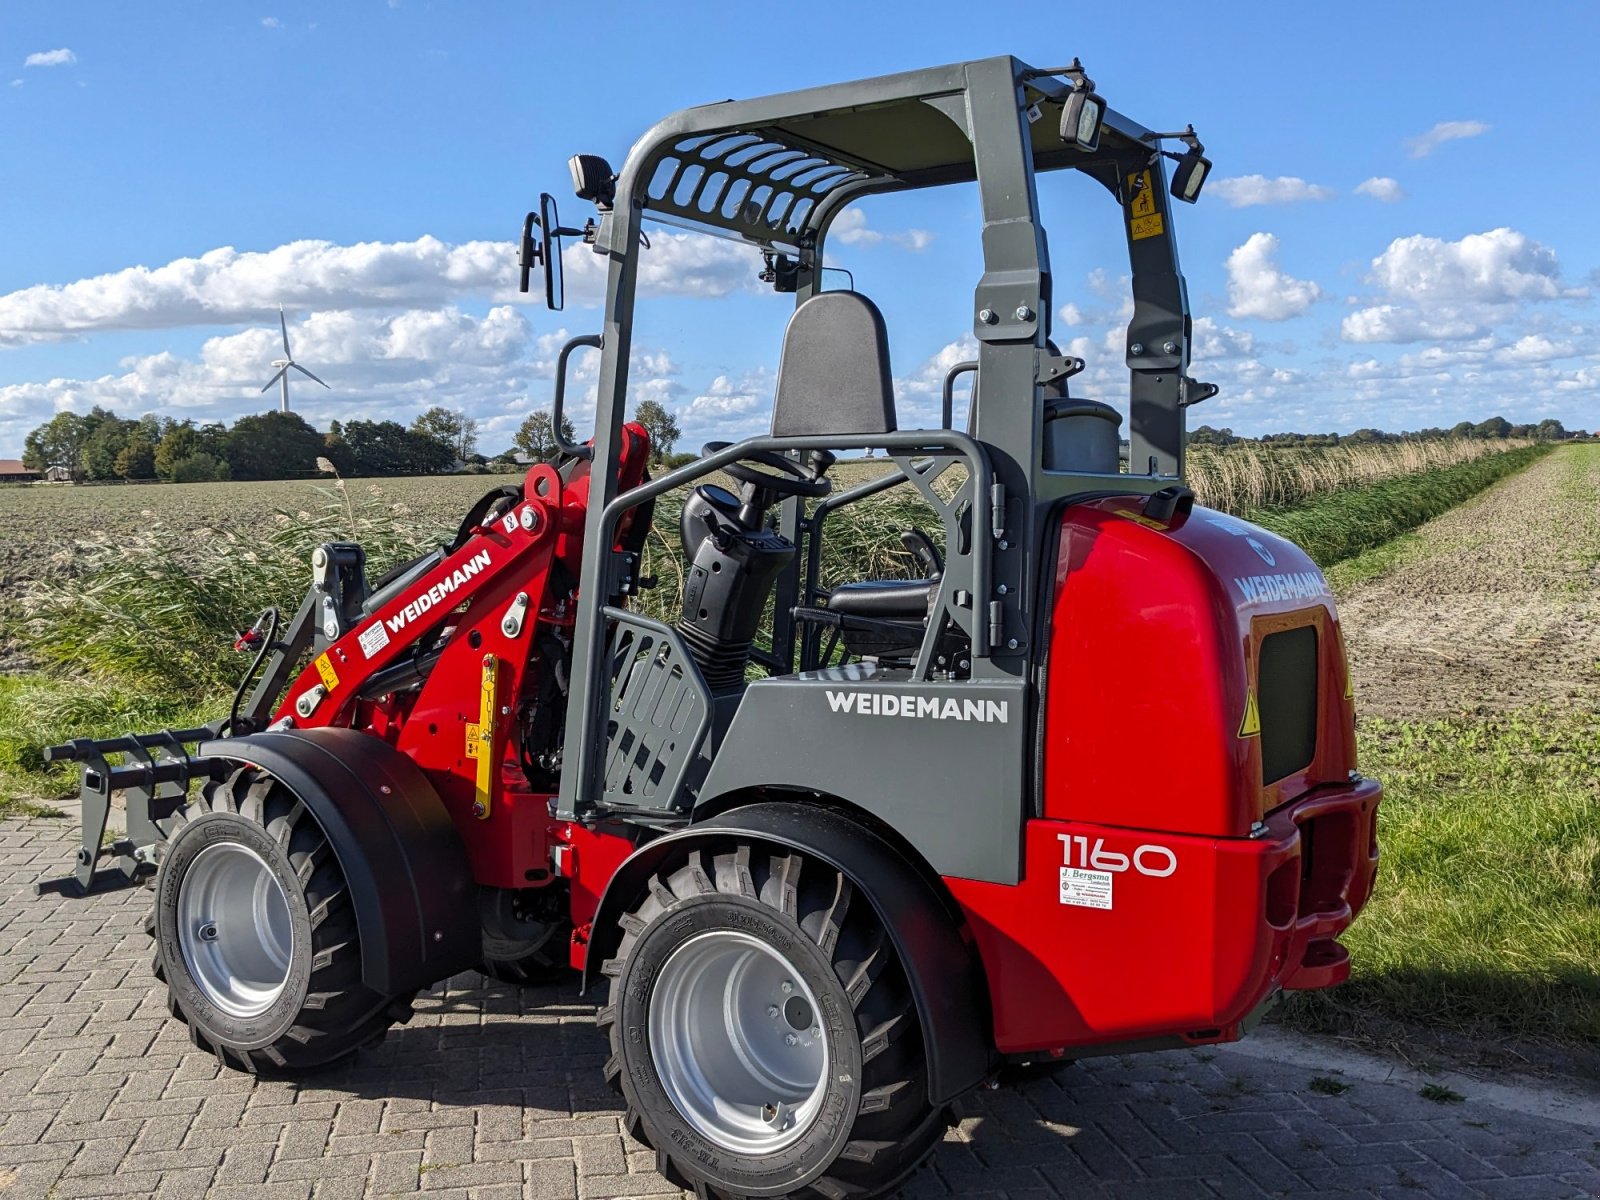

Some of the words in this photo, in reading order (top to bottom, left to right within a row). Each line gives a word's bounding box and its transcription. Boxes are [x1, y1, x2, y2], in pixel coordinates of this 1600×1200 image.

[386, 549, 492, 633] WEIDEMANN
[1234, 571, 1325, 603] WEIDEMANN
[825, 690, 1008, 723] WEIDEMANN
[1057, 833, 1177, 877] 1160
[1062, 868, 1071, 878] J.
[1072, 869, 1110, 882] Bergsma
